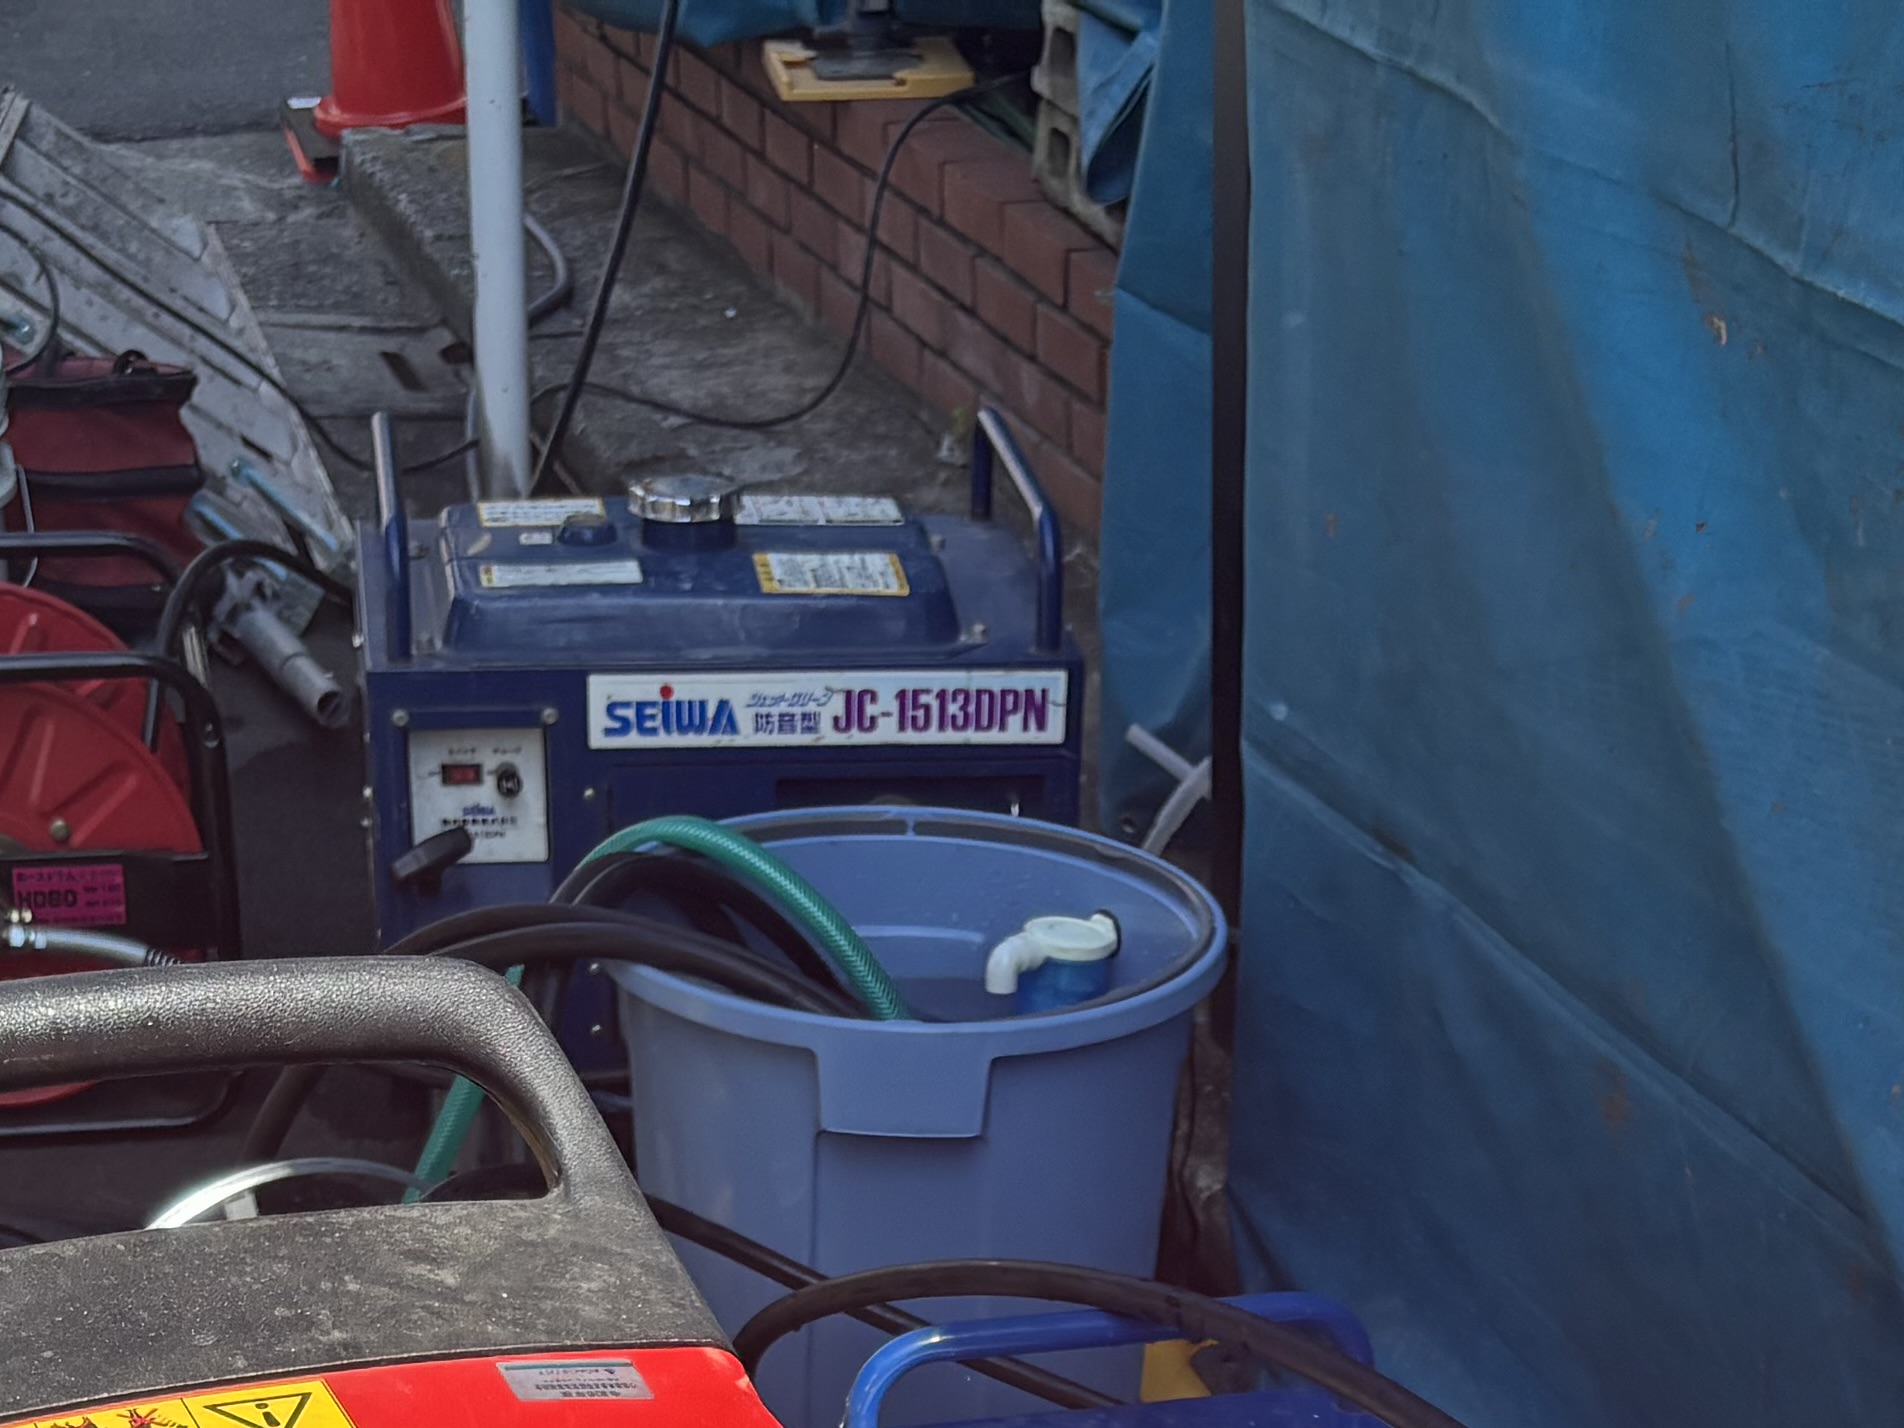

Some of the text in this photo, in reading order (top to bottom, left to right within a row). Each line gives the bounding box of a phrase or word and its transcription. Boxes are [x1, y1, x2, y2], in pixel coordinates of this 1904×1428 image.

[753, 711, 822, 736] 防音型
[833, 687, 1051, 735] JC-1513DPN
